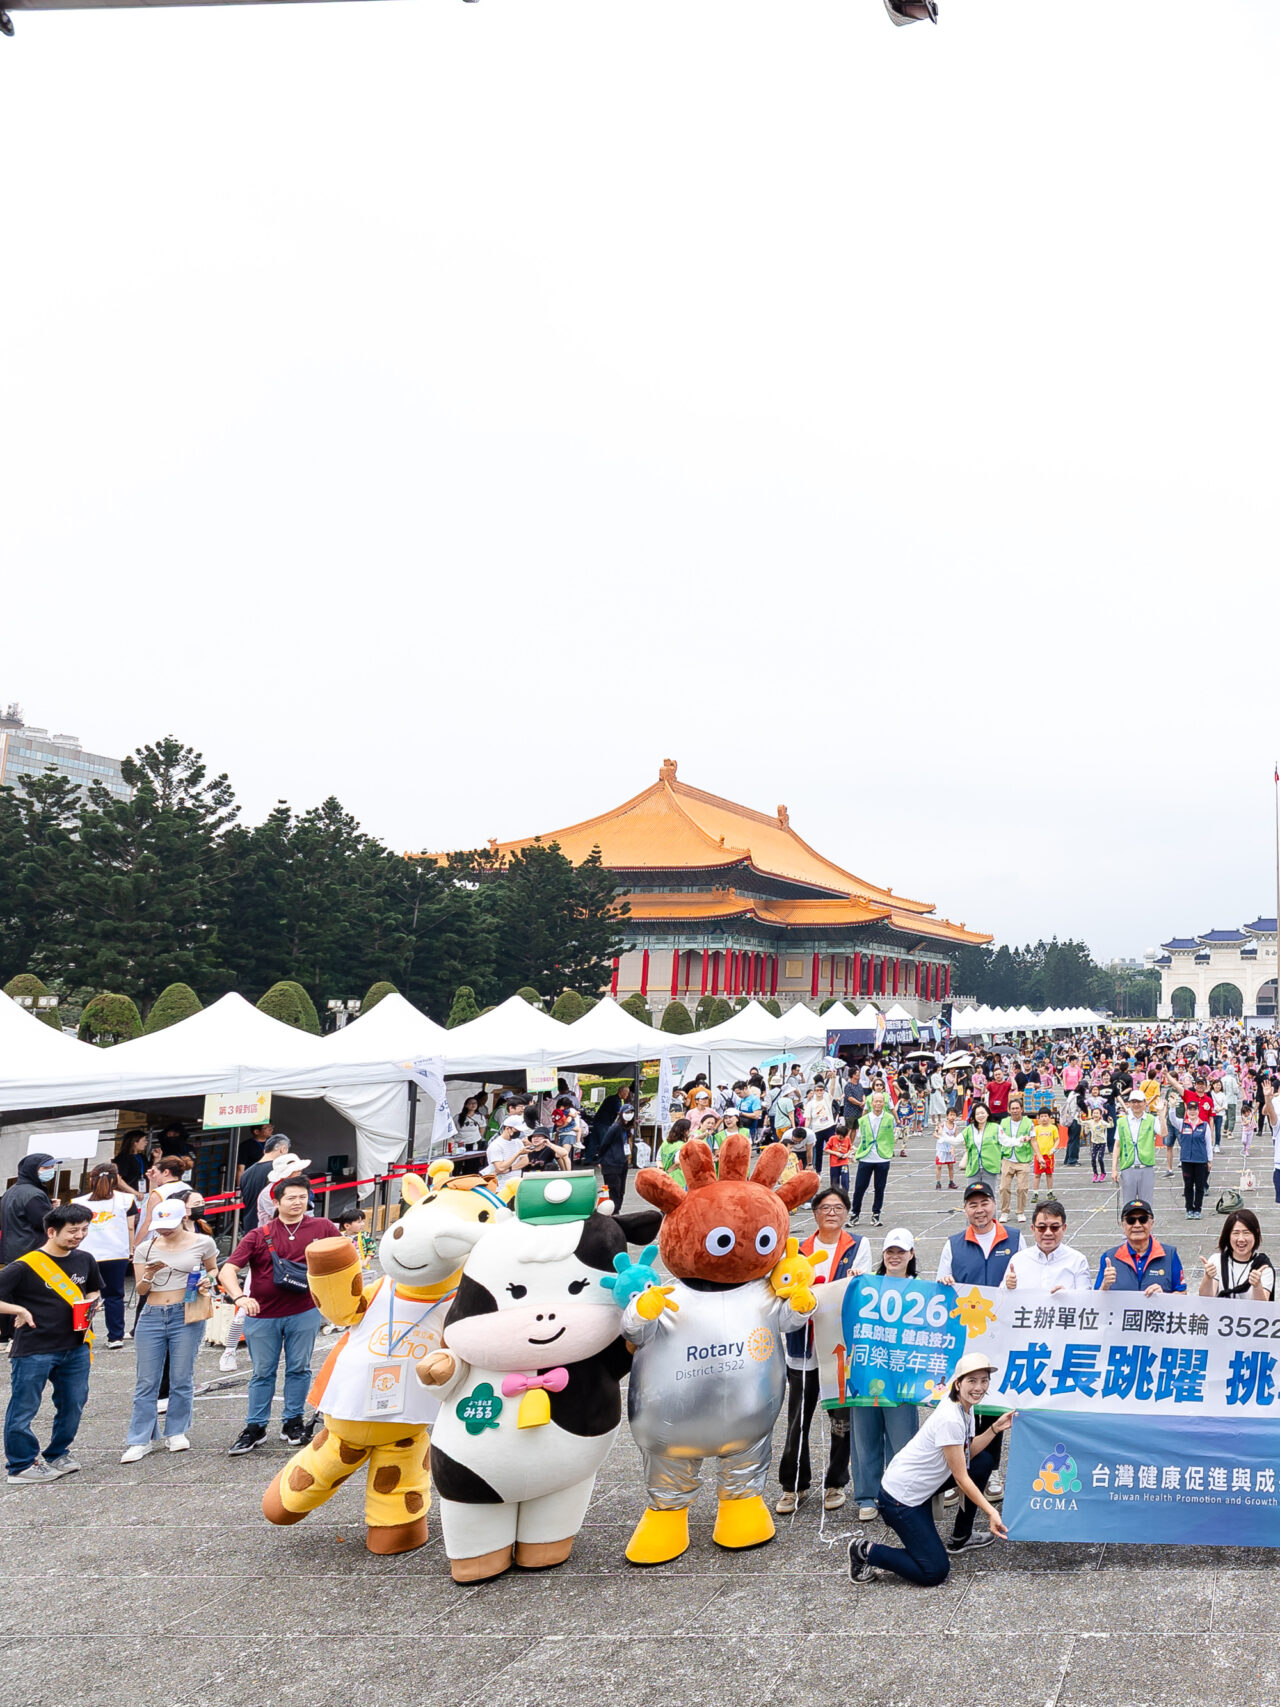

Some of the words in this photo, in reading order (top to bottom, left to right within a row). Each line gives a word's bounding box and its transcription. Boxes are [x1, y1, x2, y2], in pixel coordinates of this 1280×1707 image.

[858, 1287, 948, 1328] 2026
[901, 1329, 956, 1349] 健康接力
[686, 1341, 744, 1362] Rotary
[853, 1343, 949, 1375] 同樂嘉年華
[675, 1365, 714, 1381] District
[717, 1359, 745, 1374] 3522
[999, 1342, 1209, 1403] 成長跳躍
[463, 1407, 492, 1419] みるる
[1030, 1498, 1079, 1511] GCMA
[1109, 1491, 1140, 1501] Taiwan
[1143, 1493, 1173, 1502] Health
[1176, 1494, 1222, 1504] Promotion
[1225, 1496, 1242, 1505] and
[1245, 1496, 1278, 1507] Growth
